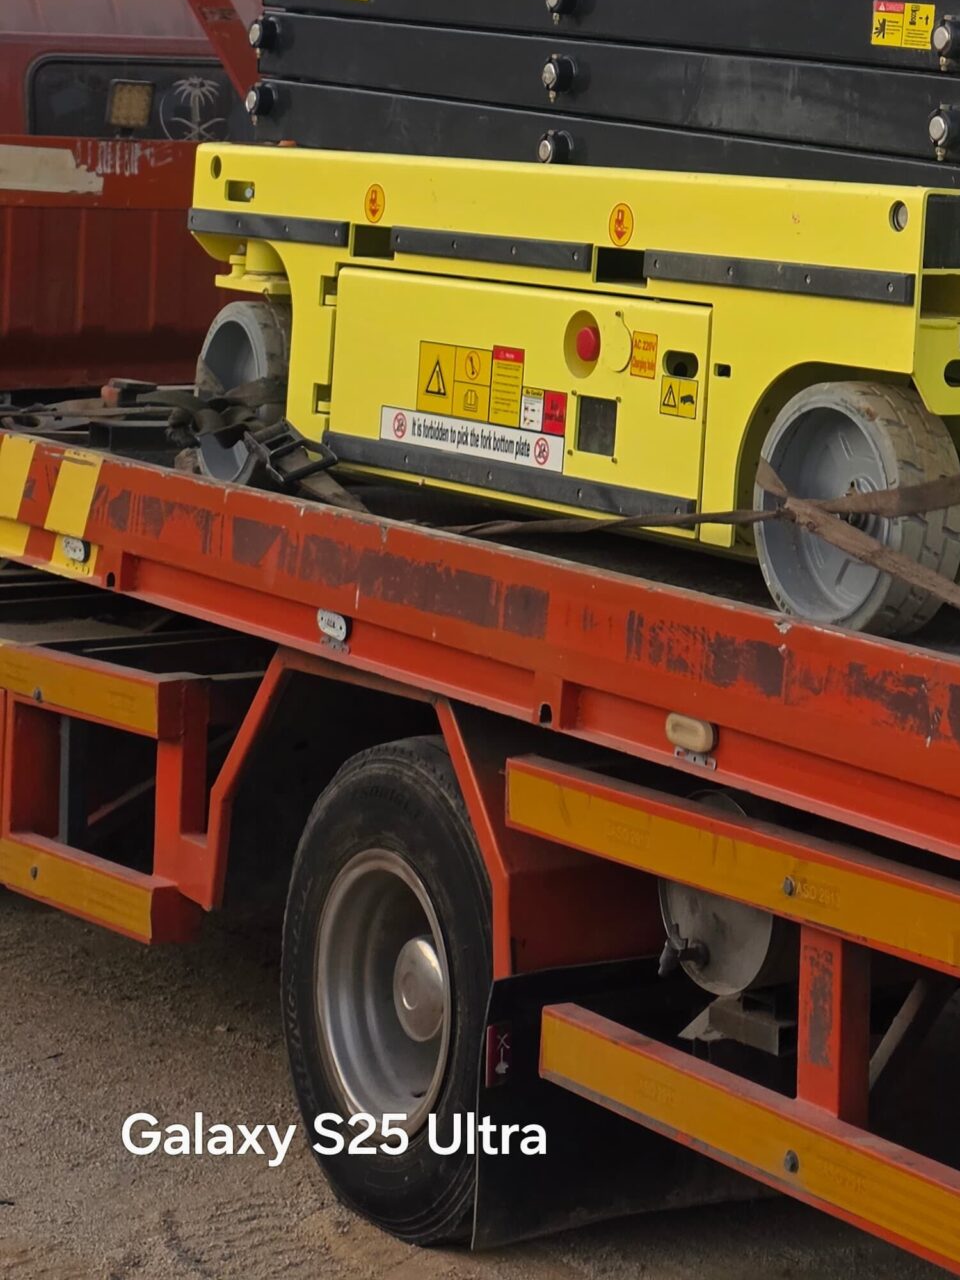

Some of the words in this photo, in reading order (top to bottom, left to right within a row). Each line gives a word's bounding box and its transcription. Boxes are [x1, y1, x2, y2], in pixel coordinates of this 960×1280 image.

[412, 417, 417, 436] It
[417, 419, 422, 437] is
[422, 419, 450, 441] forbidden
[450, 428, 456, 443] to
[456, 425, 469, 448] pick
[470, 428, 480, 446] the
[480, 429, 492, 450] fork
[493, 432, 514, 453] bottom
[515, 435, 531, 460] plate
